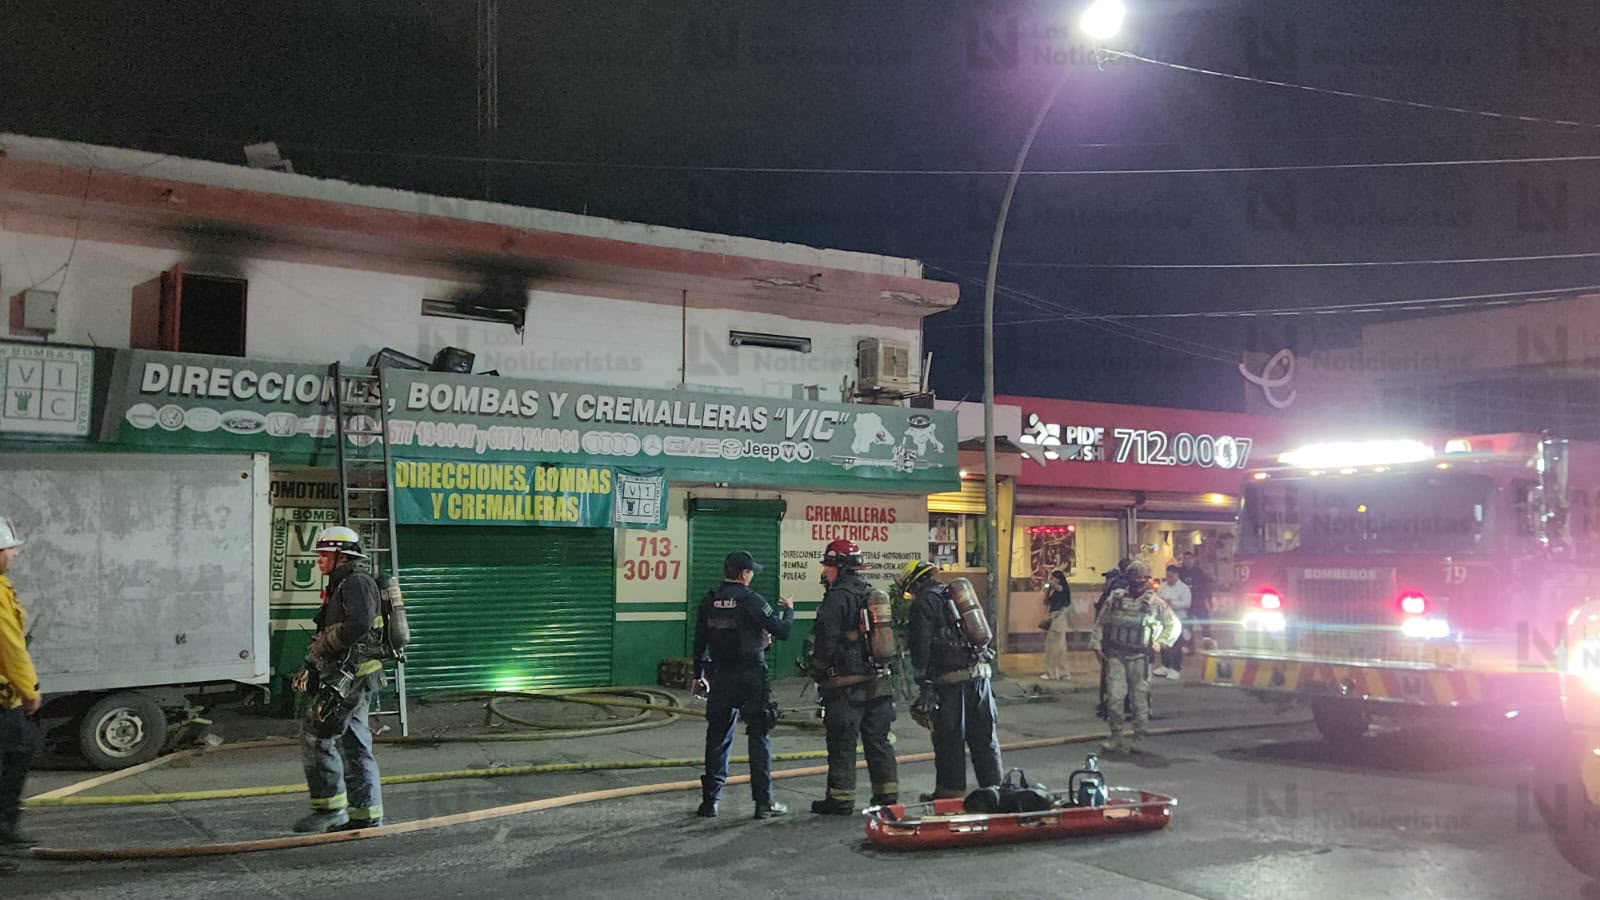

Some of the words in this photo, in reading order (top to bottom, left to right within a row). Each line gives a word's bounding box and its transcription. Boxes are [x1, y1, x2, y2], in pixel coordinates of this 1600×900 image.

[408, 381, 539, 418] BOMBAS
[549, 391, 568, 418] Y
[575, 393, 768, 432] CREMALLERAS
[1067, 426, 1104, 445] PIDE
[743, 441, 780, 460] Jeep
[1114, 428, 1252, 469] 712.0007
[395, 461, 531, 492] DIRECCIONES,
[534, 465, 611, 495] BOMBAS
[431, 492, 445, 519] Y
[448, 493, 579, 522] CREMALLERAS
[806, 505, 896, 524] CREMALLERAS
[811, 524, 889, 542] ELECTRICAS
[272, 518, 286, 591] DIRECCIONES
[1303, 567, 1377, 581] BOMBEROS
